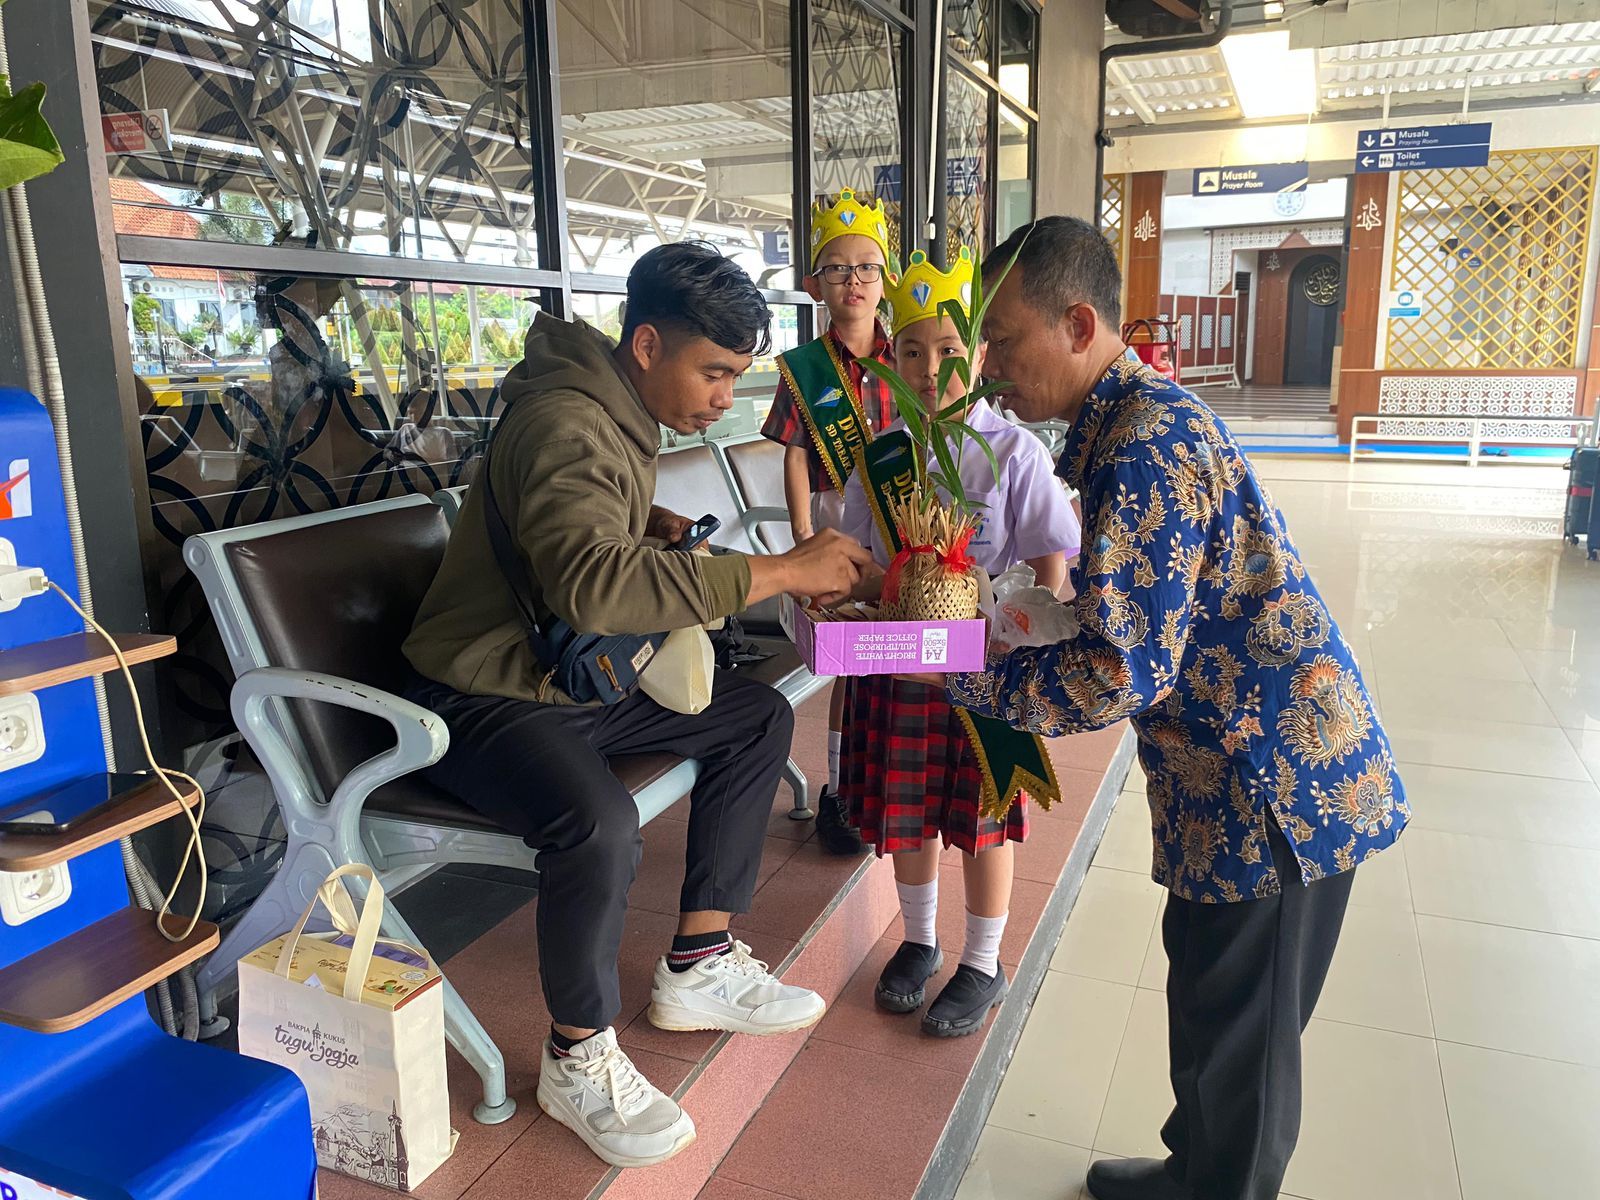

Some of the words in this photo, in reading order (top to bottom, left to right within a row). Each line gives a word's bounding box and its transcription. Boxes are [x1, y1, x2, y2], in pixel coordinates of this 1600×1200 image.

[1398, 129, 1430, 138] Musala
[1396, 152, 1420, 160] Toilet
[1222, 170, 1258, 181] Musala
[1221, 181, 1244, 190] Prayer
[1244, 181, 1264, 189] Room
[825, 423, 838, 438] SD
[858, 634, 885, 642] PAPER
[886, 633, 918, 641] OFFICE
[853, 643, 917, 651] MULTIPURPOSE
[925, 649, 944, 660] A4
[287, 1021, 311, 1034] BAKPIA
[323, 1033, 346, 1045] KUKUS
[274, 1024, 314, 1055] tugu
[310, 1041, 359, 1069] jogja
